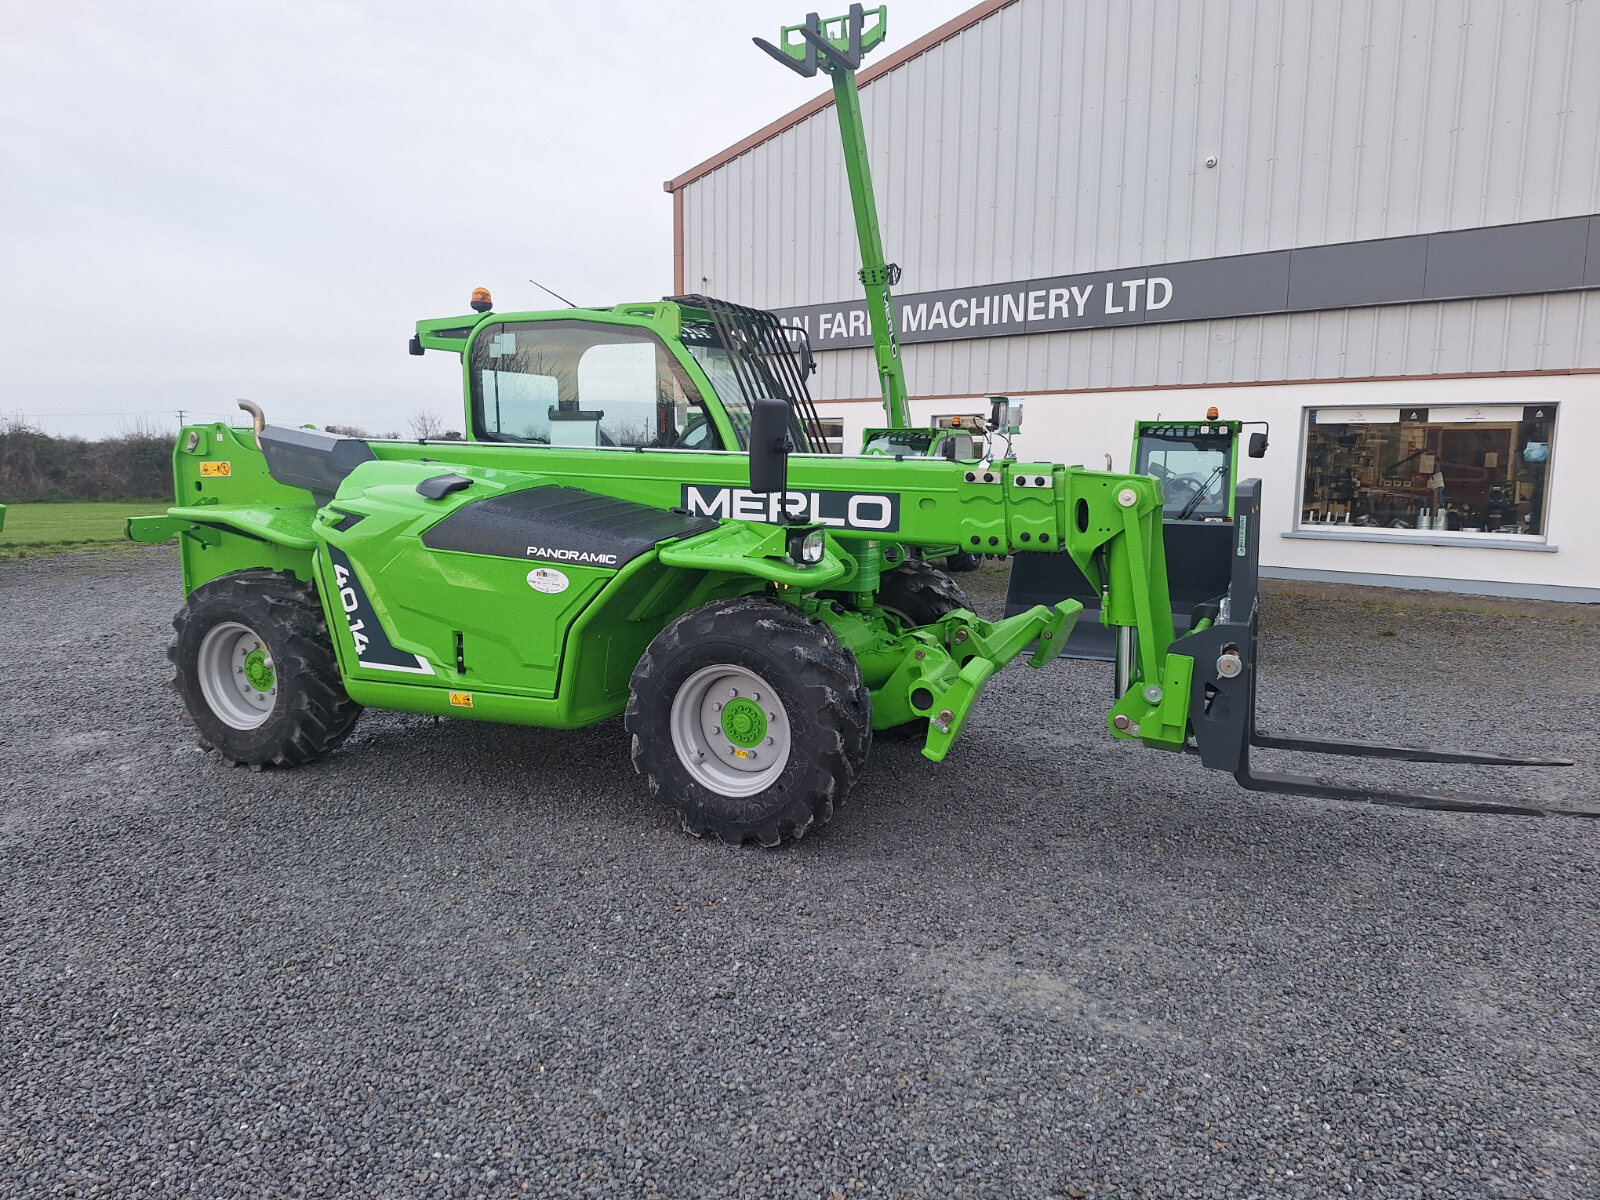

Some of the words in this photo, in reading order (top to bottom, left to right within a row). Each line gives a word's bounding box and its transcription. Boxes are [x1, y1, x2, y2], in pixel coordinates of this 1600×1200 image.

[882, 290, 898, 359] MERLO
[901, 284, 1094, 333] MACHINERY
[1104, 277, 1173, 315] LTD
[687, 486, 892, 529] MERLO
[526, 546, 617, 565] PANORAMIC
[333, 564, 370, 656] 40.14
